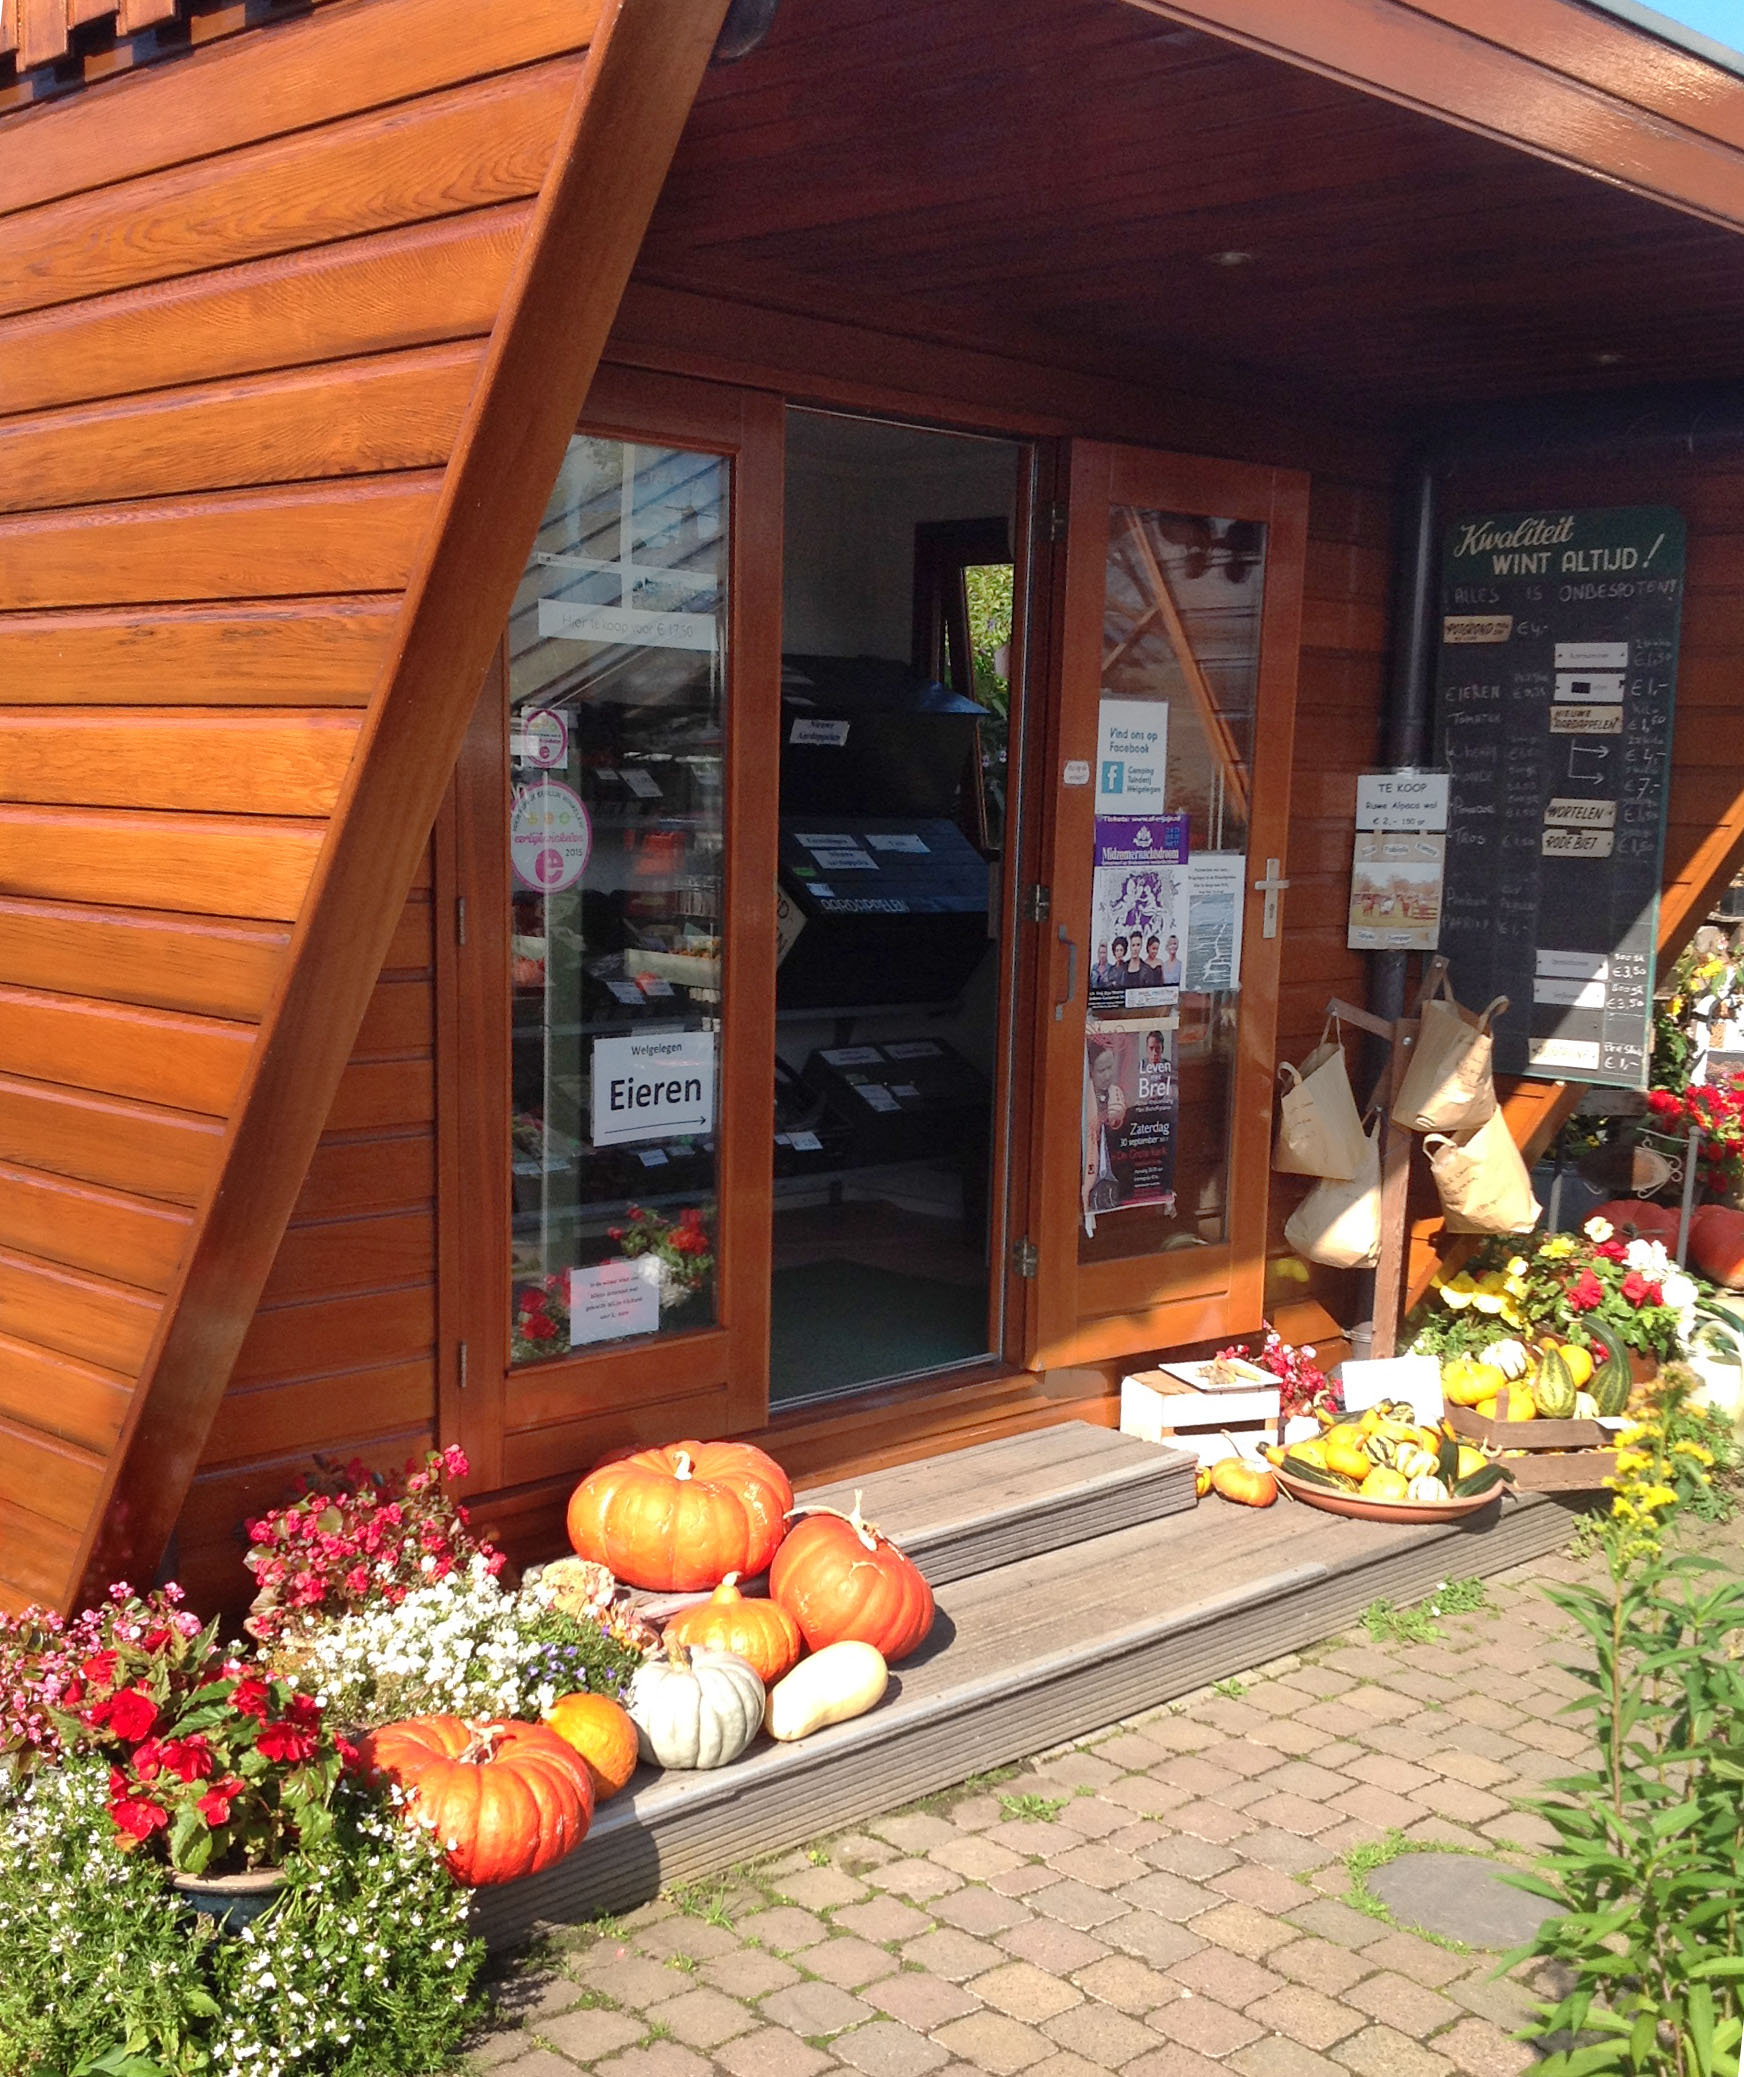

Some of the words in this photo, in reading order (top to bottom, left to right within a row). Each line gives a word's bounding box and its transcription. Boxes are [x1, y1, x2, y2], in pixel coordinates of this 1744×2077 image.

[1455, 515, 1574, 557] Kwaliteit
[1493, 552, 1550, 575] WINT
[562, 614, 587, 630] Hier
[601, 618, 628, 634] koop
[1110, 727, 1129, 739] Vind
[1130, 731, 1145, 741] ons
[1146, 731, 1158, 743] op
[1109, 740, 1149, 753] Facebook
[1127, 766, 1155, 777] Camping
[1377, 783, 1393, 793] TE
[1396, 782, 1428, 794] KOOP
[1391, 800, 1421, 812] Alpaca
[1548, 804, 1604, 819] WORTELEN
[1545, 835, 1573, 849] RODE
[1573, 836, 1599, 850] BIET
[631, 1042, 682, 1056] Welgelegen
[1139, 1060, 1172, 1075] Leven
[609, 1076, 702, 1112] Eieren
[1139, 1076, 1171, 1099] Brel
[1129, 1121, 1170, 1136] Zaterdag
[1120, 1137, 1128, 1147] 30
[1128, 1136, 1159, 1147] september
